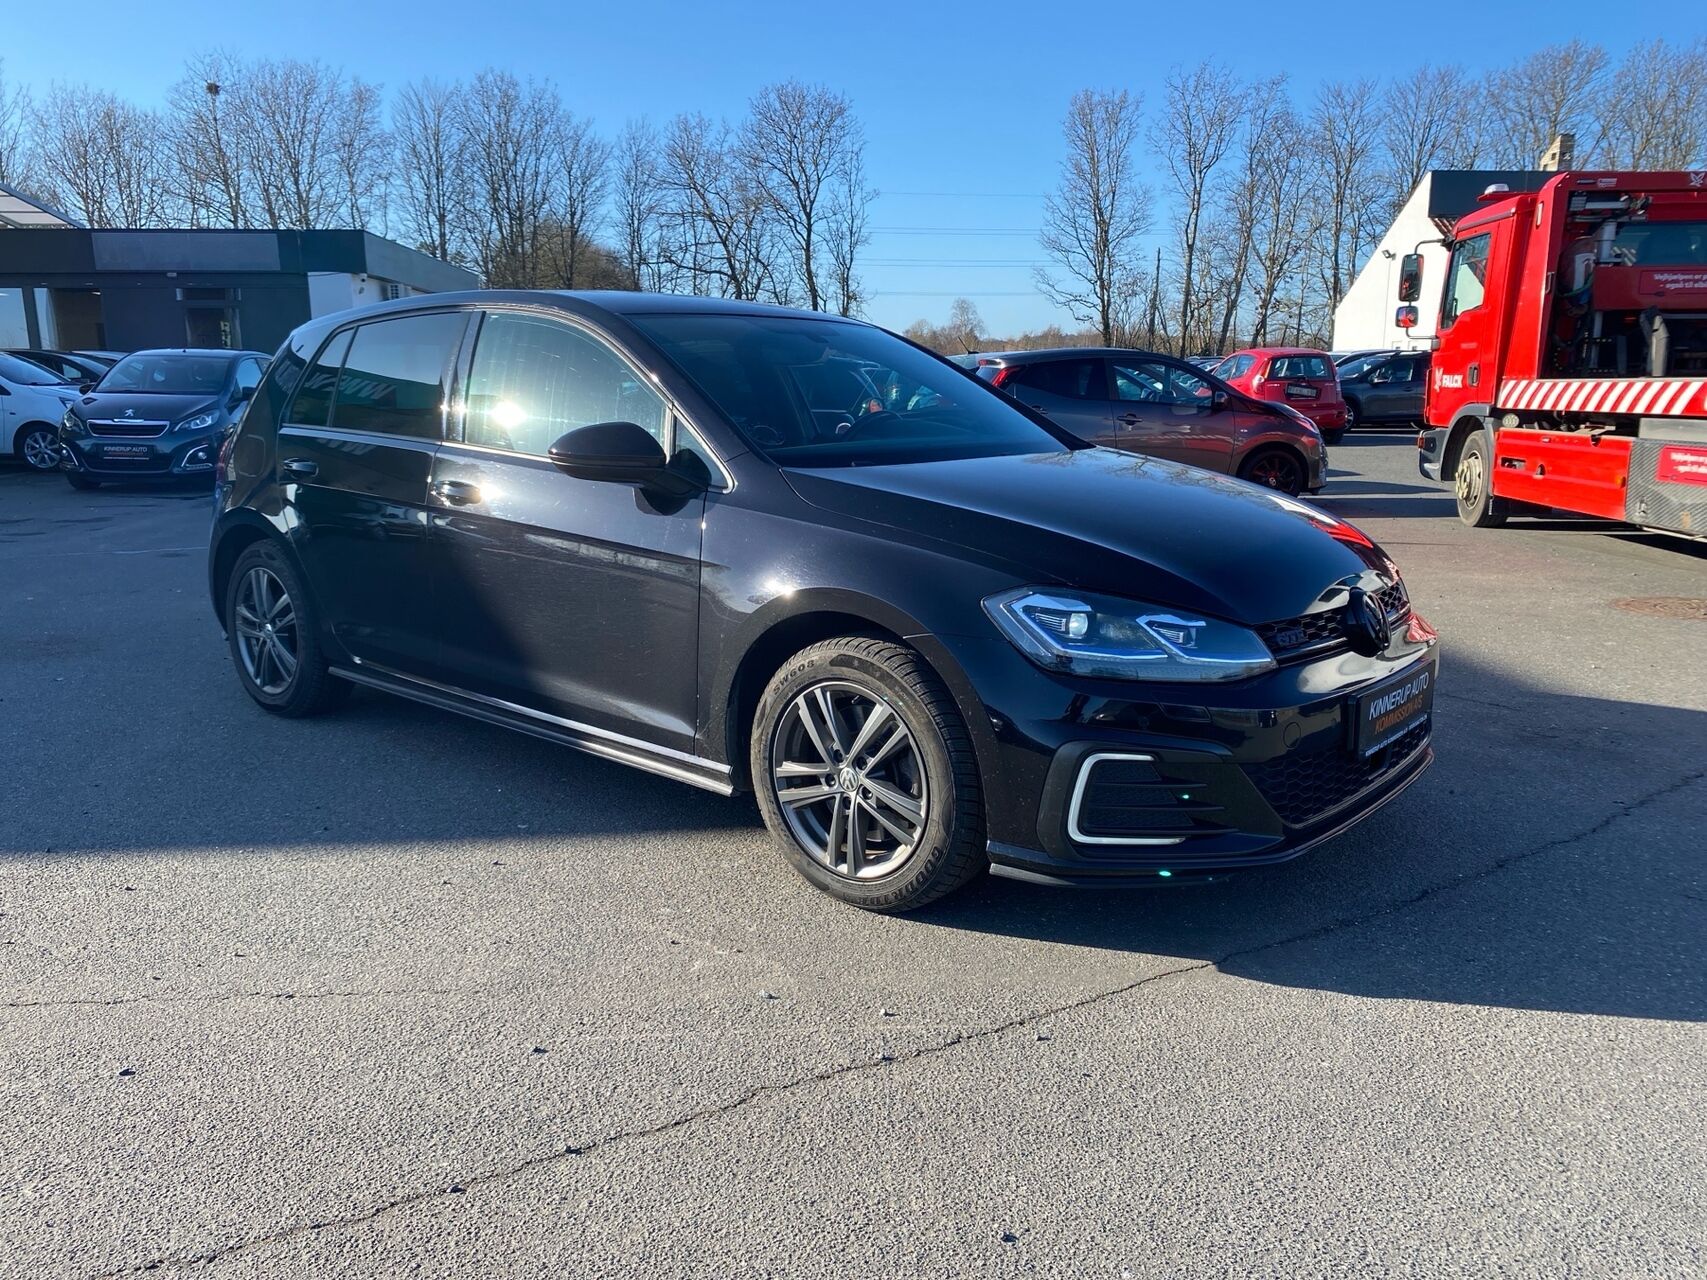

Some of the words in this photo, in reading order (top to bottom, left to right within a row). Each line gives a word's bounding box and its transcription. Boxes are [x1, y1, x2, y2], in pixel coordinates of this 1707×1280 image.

[1442, 374, 1463, 388] FALCK
[773, 660, 814, 695] SW608
[1369, 683, 1412, 720] KINNERUP
[1410, 672, 1429, 698] AUTO
